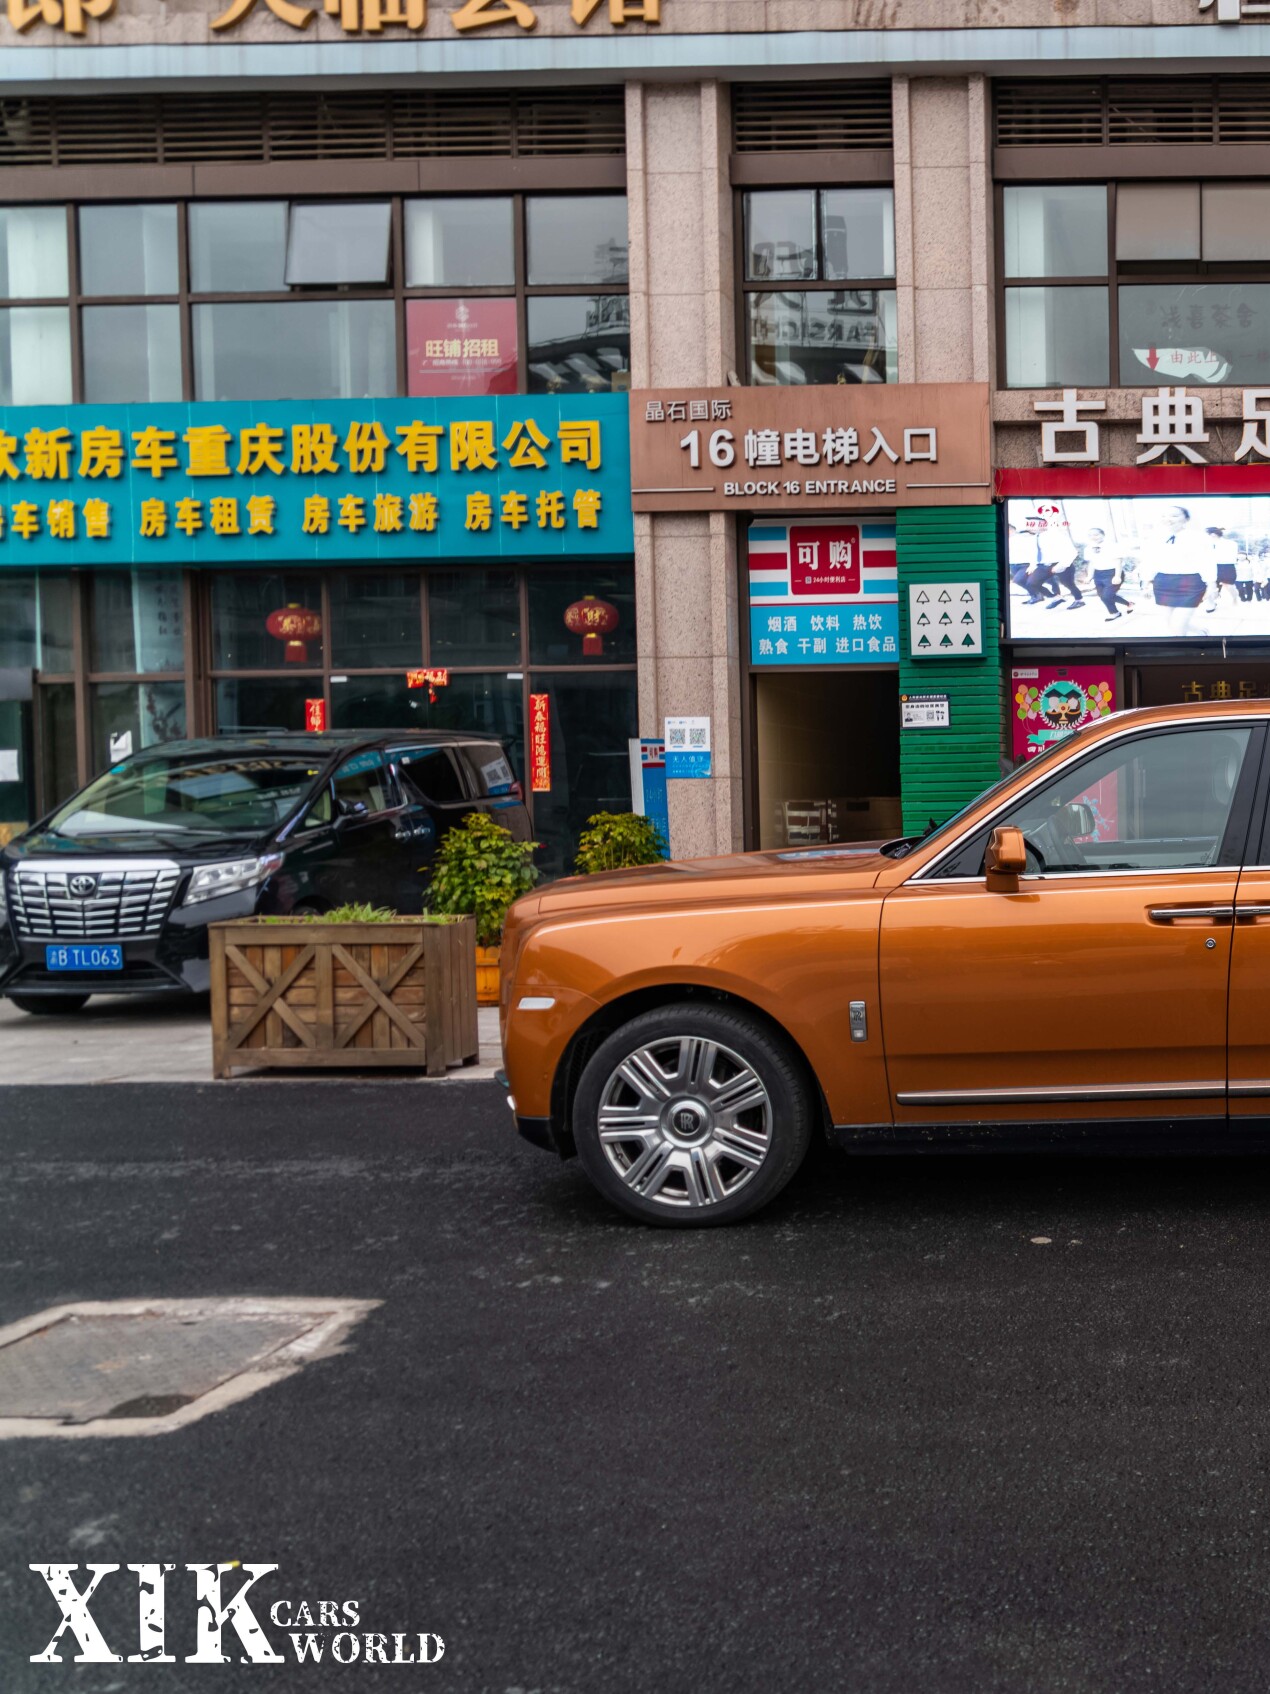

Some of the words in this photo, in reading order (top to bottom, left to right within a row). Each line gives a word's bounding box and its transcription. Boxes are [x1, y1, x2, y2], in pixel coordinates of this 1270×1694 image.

[425, 339, 499, 358] 旺铺招租
[645, 399, 732, 422] 晶石国际
[724, 481, 779, 496] BLOCK
[783, 481, 799, 495] 16
[805, 479, 896, 495] ENTRANCE
[0, 498, 110, 539] 车销售
[140, 495, 275, 536] 房车租赁
[302, 492, 439, 533] 房车旅游
[466, 489, 602, 530] 房车托管
[797, 540, 852, 570] 可购
[768, 616, 797, 632] 烟酒
[810, 615, 840, 632] 饮料
[853, 614, 882, 630] 热饮
[759, 638, 788, 655] 熟食
[797, 637, 827, 654] 干副
[836, 636, 896, 653] 进口食品
